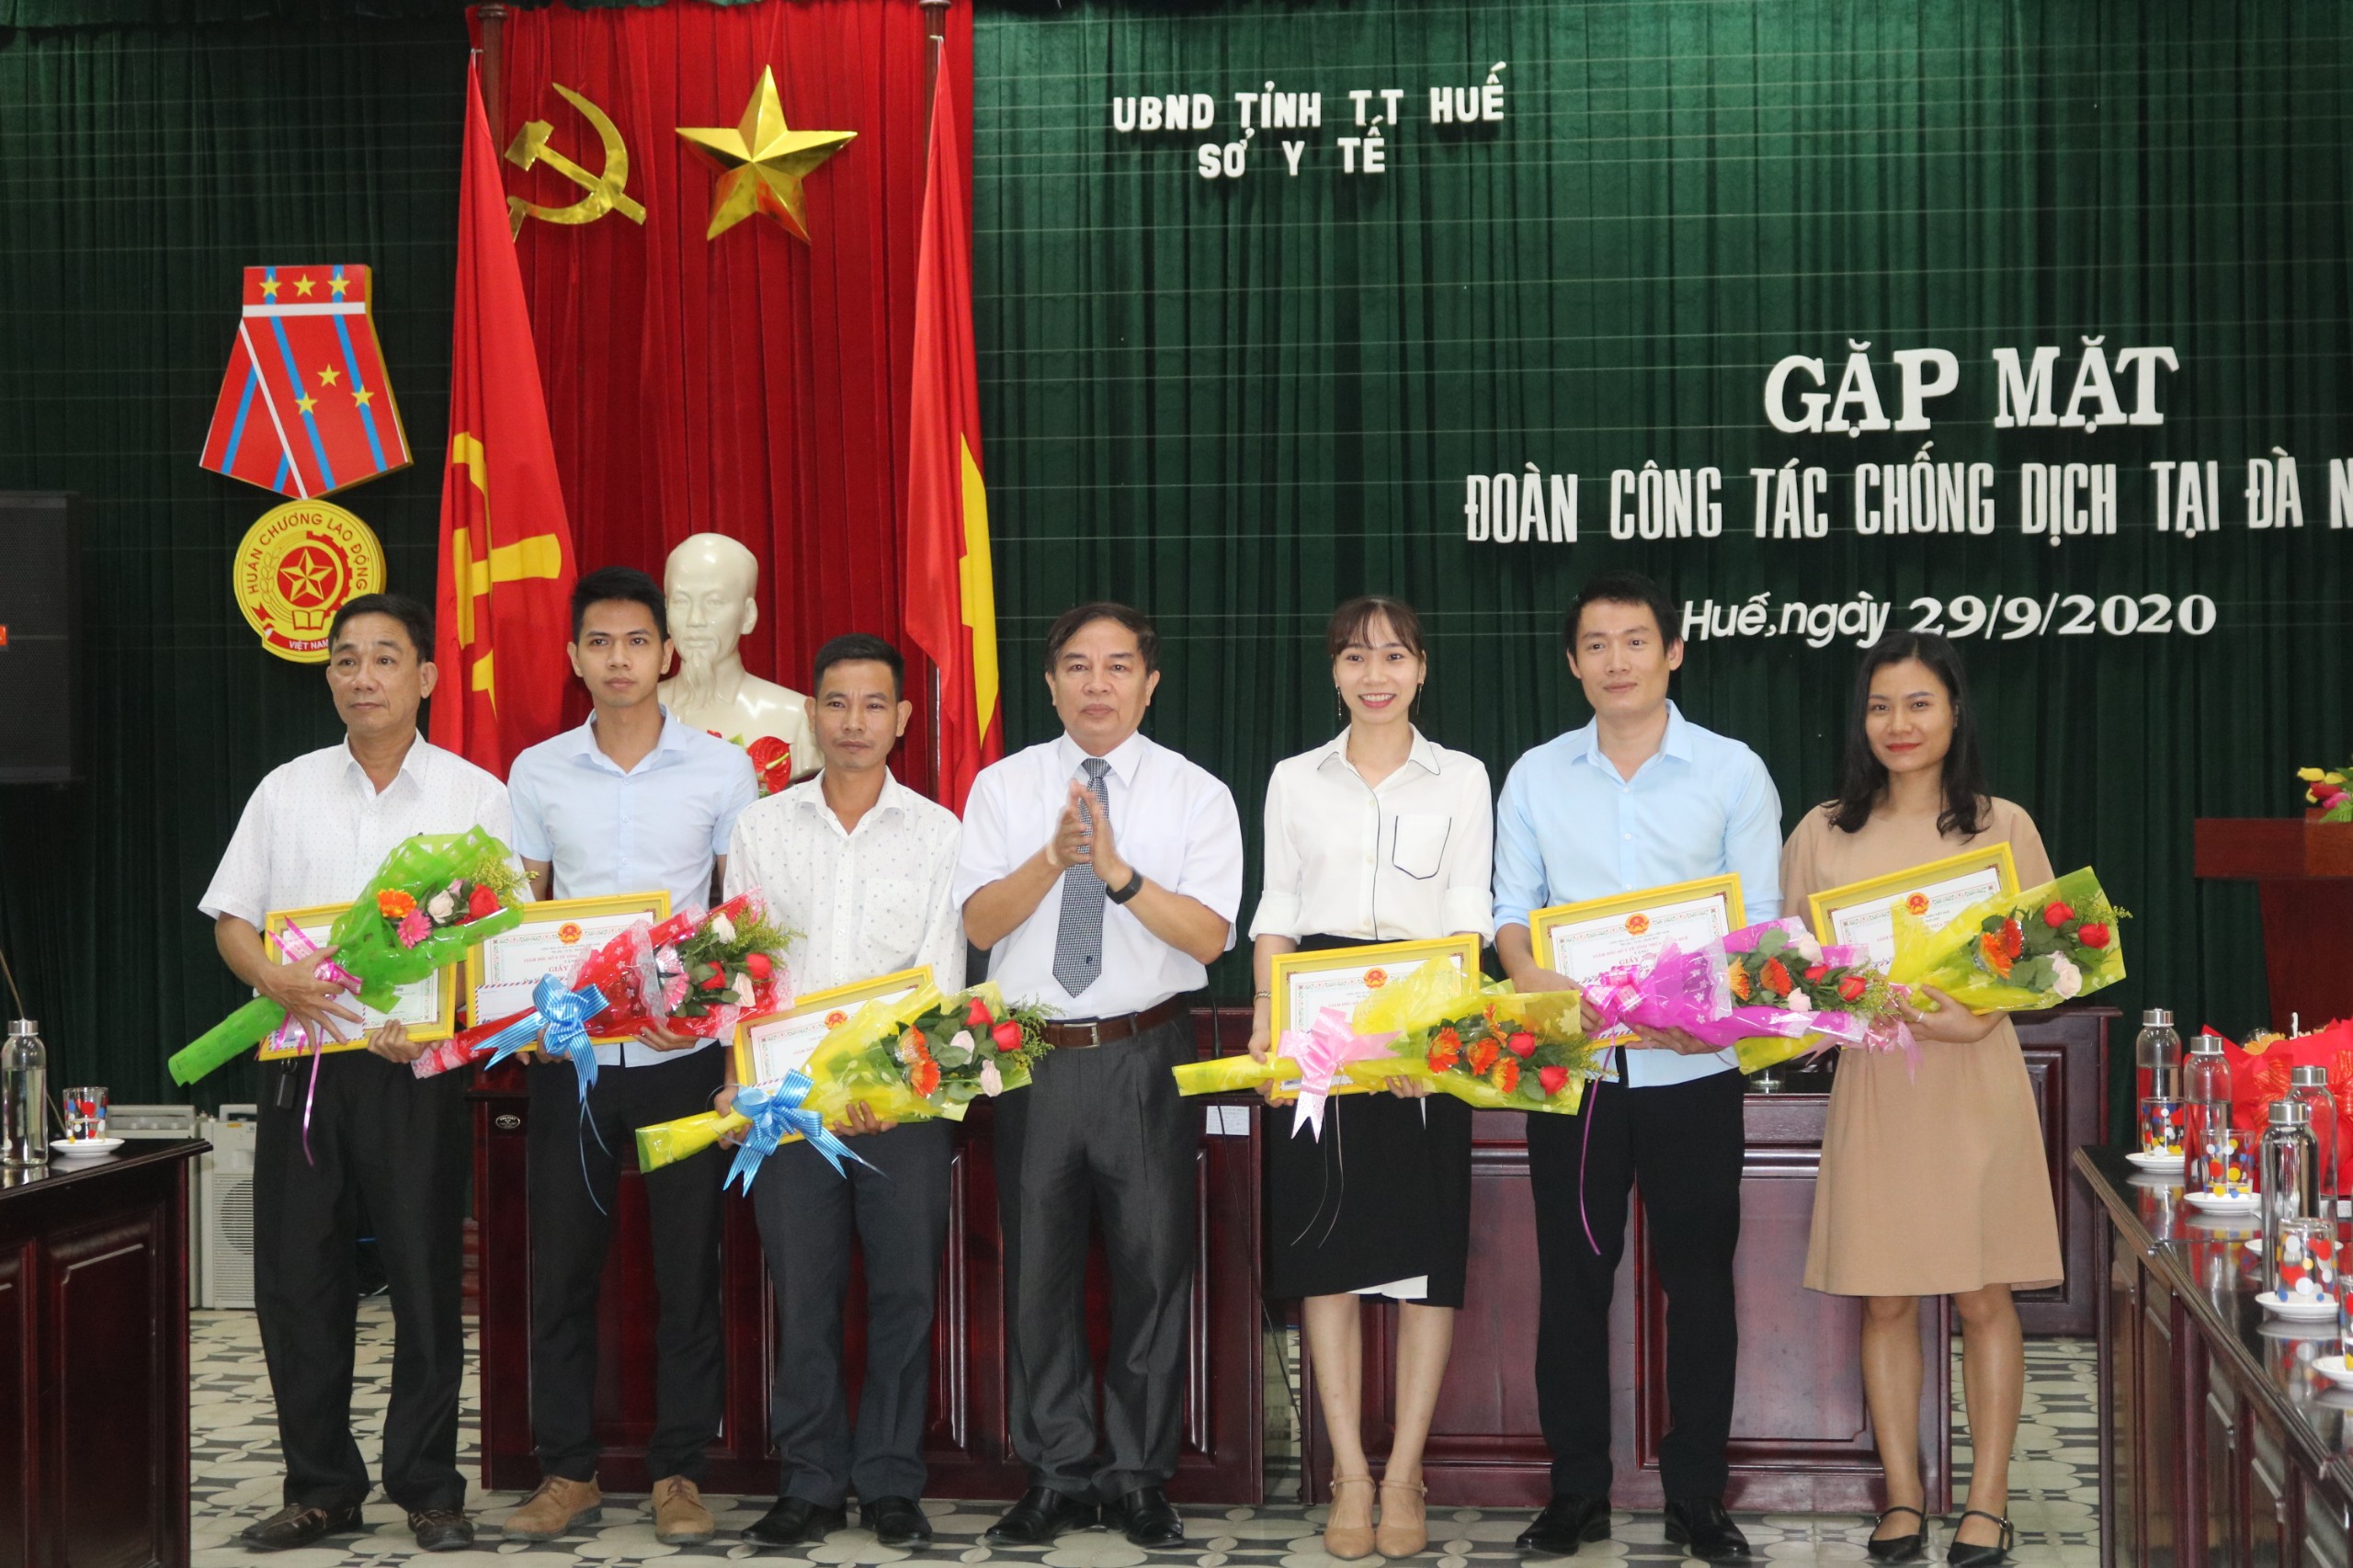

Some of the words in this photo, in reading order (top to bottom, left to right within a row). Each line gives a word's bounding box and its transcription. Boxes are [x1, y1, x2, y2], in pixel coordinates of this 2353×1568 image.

[1112, 93, 1215, 132] UBND
[1234, 80, 1322, 128] TỈNH
[1429, 61, 1507, 124] HUẾ
[1198, 127, 1256, 178] SỞ
[1281, 140, 1306, 176] Y
[1336, 114, 1386, 174] TẾ
[1764, 337, 1960, 438] GẶP
[1992, 335, 2180, 434] MẶT
[1464, 461, 1578, 543] ĐOÀN
[1609, 459, 1722, 540] CÔNG
[1749, 457, 1829, 539] TÁC
[1855, 440, 1995, 535] CHỐNG
[2021, 462, 2117, 547] DỊCH
[2150, 460, 2220, 539] TẠI
[2245, 446, 2303, 528] ĐÀ
[326, 517, 353, 542] LAO
[289, 639, 309, 652] VIỆT
[1909, 592, 2217, 640] 29/9/2020
